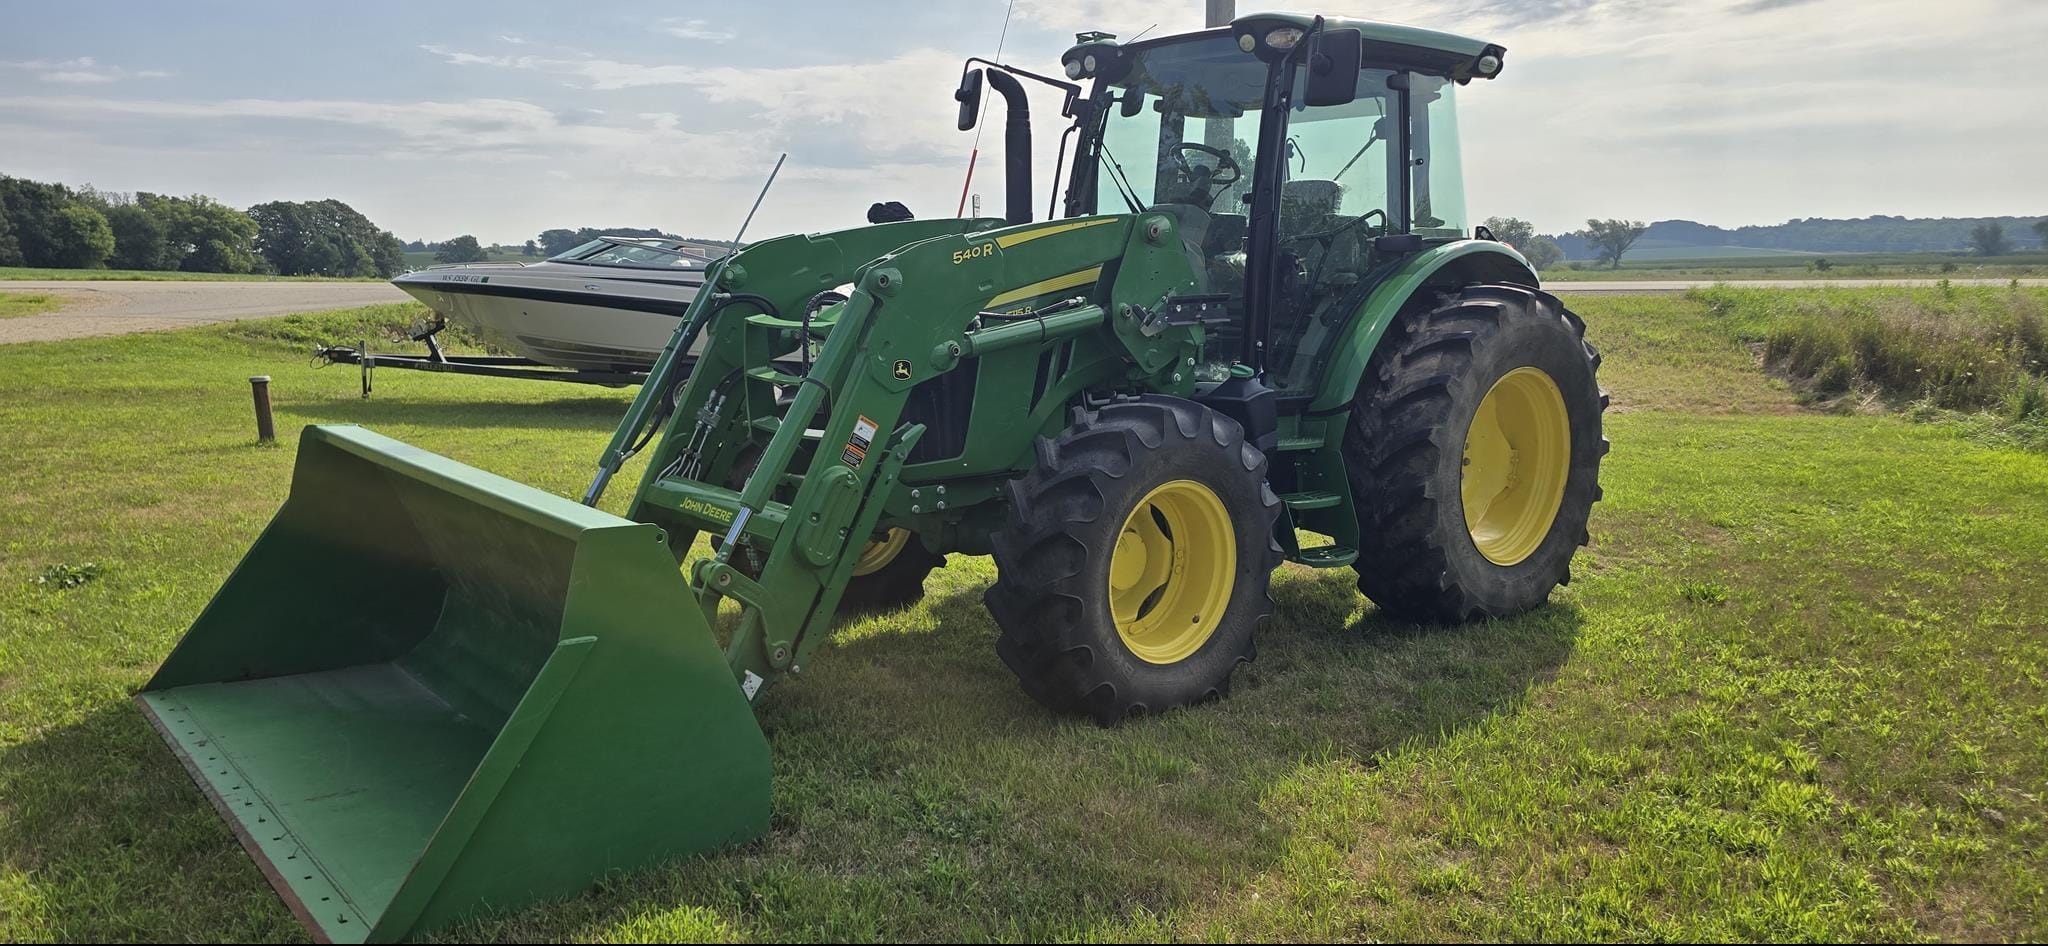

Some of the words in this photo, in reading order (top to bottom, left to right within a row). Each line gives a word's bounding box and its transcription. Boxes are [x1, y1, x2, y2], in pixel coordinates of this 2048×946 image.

[953, 246, 981, 265] 540
[983, 243, 993, 257] R
[680, 497, 704, 513] JOHN
[703, 503, 733, 522] DEERE
